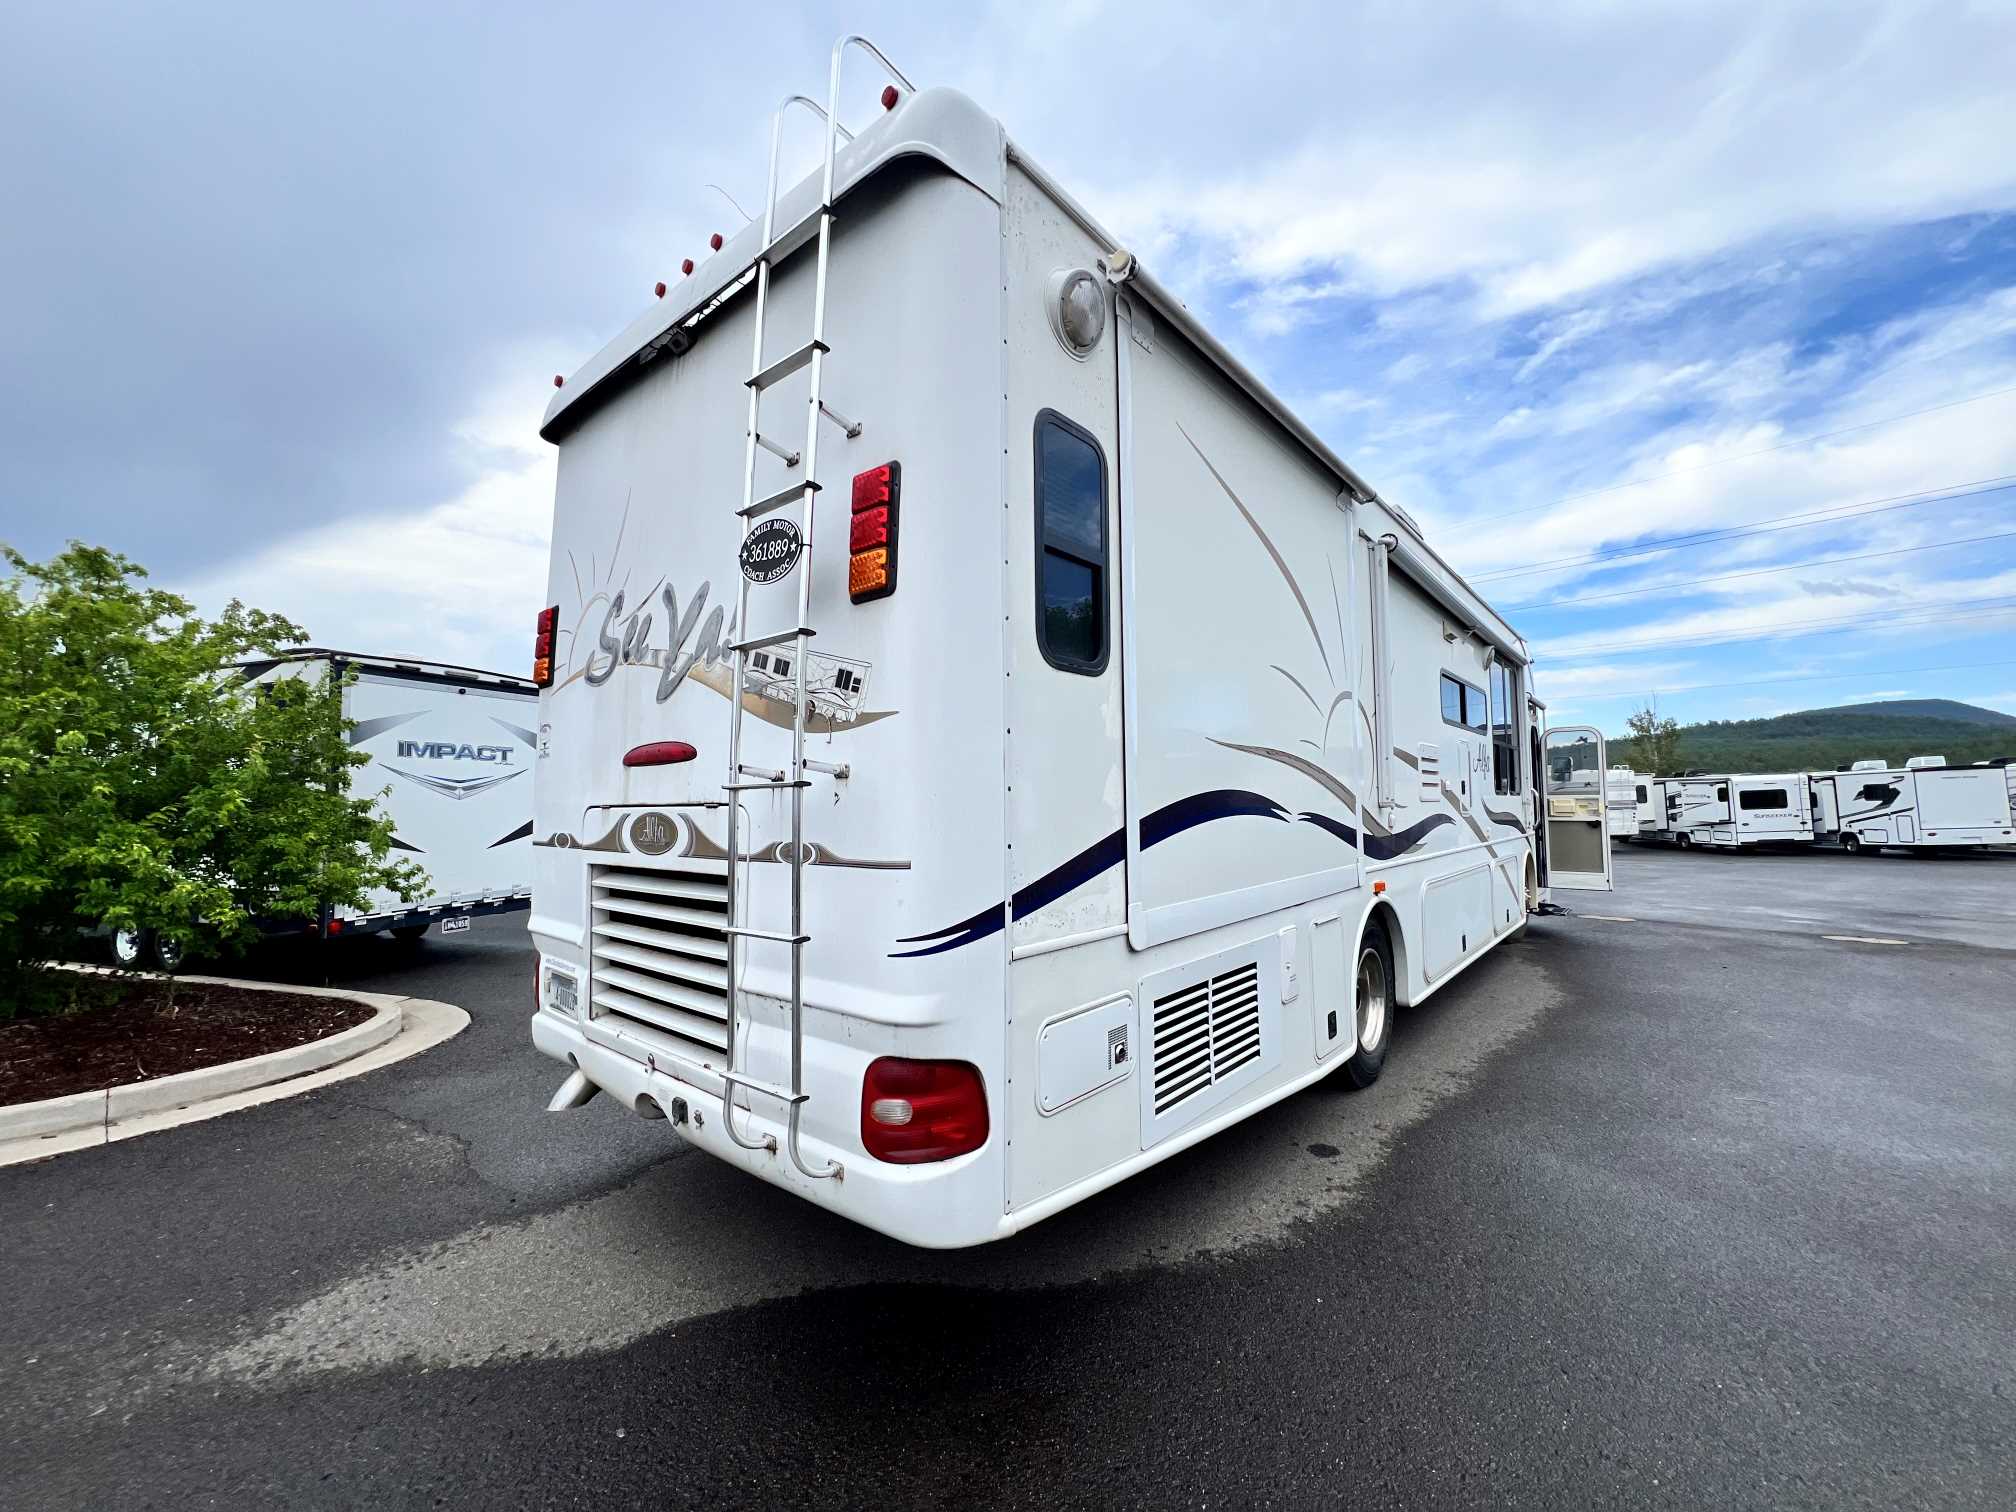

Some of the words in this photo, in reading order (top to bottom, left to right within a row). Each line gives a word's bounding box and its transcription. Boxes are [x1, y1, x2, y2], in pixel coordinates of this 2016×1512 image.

[746, 521, 772, 546] FAMILY
[773, 520, 796, 538] MOTOR
[748, 538, 789, 563] 361889
[743, 565, 765, 581] COACH
[397, 740, 514, 762] IMPACT
